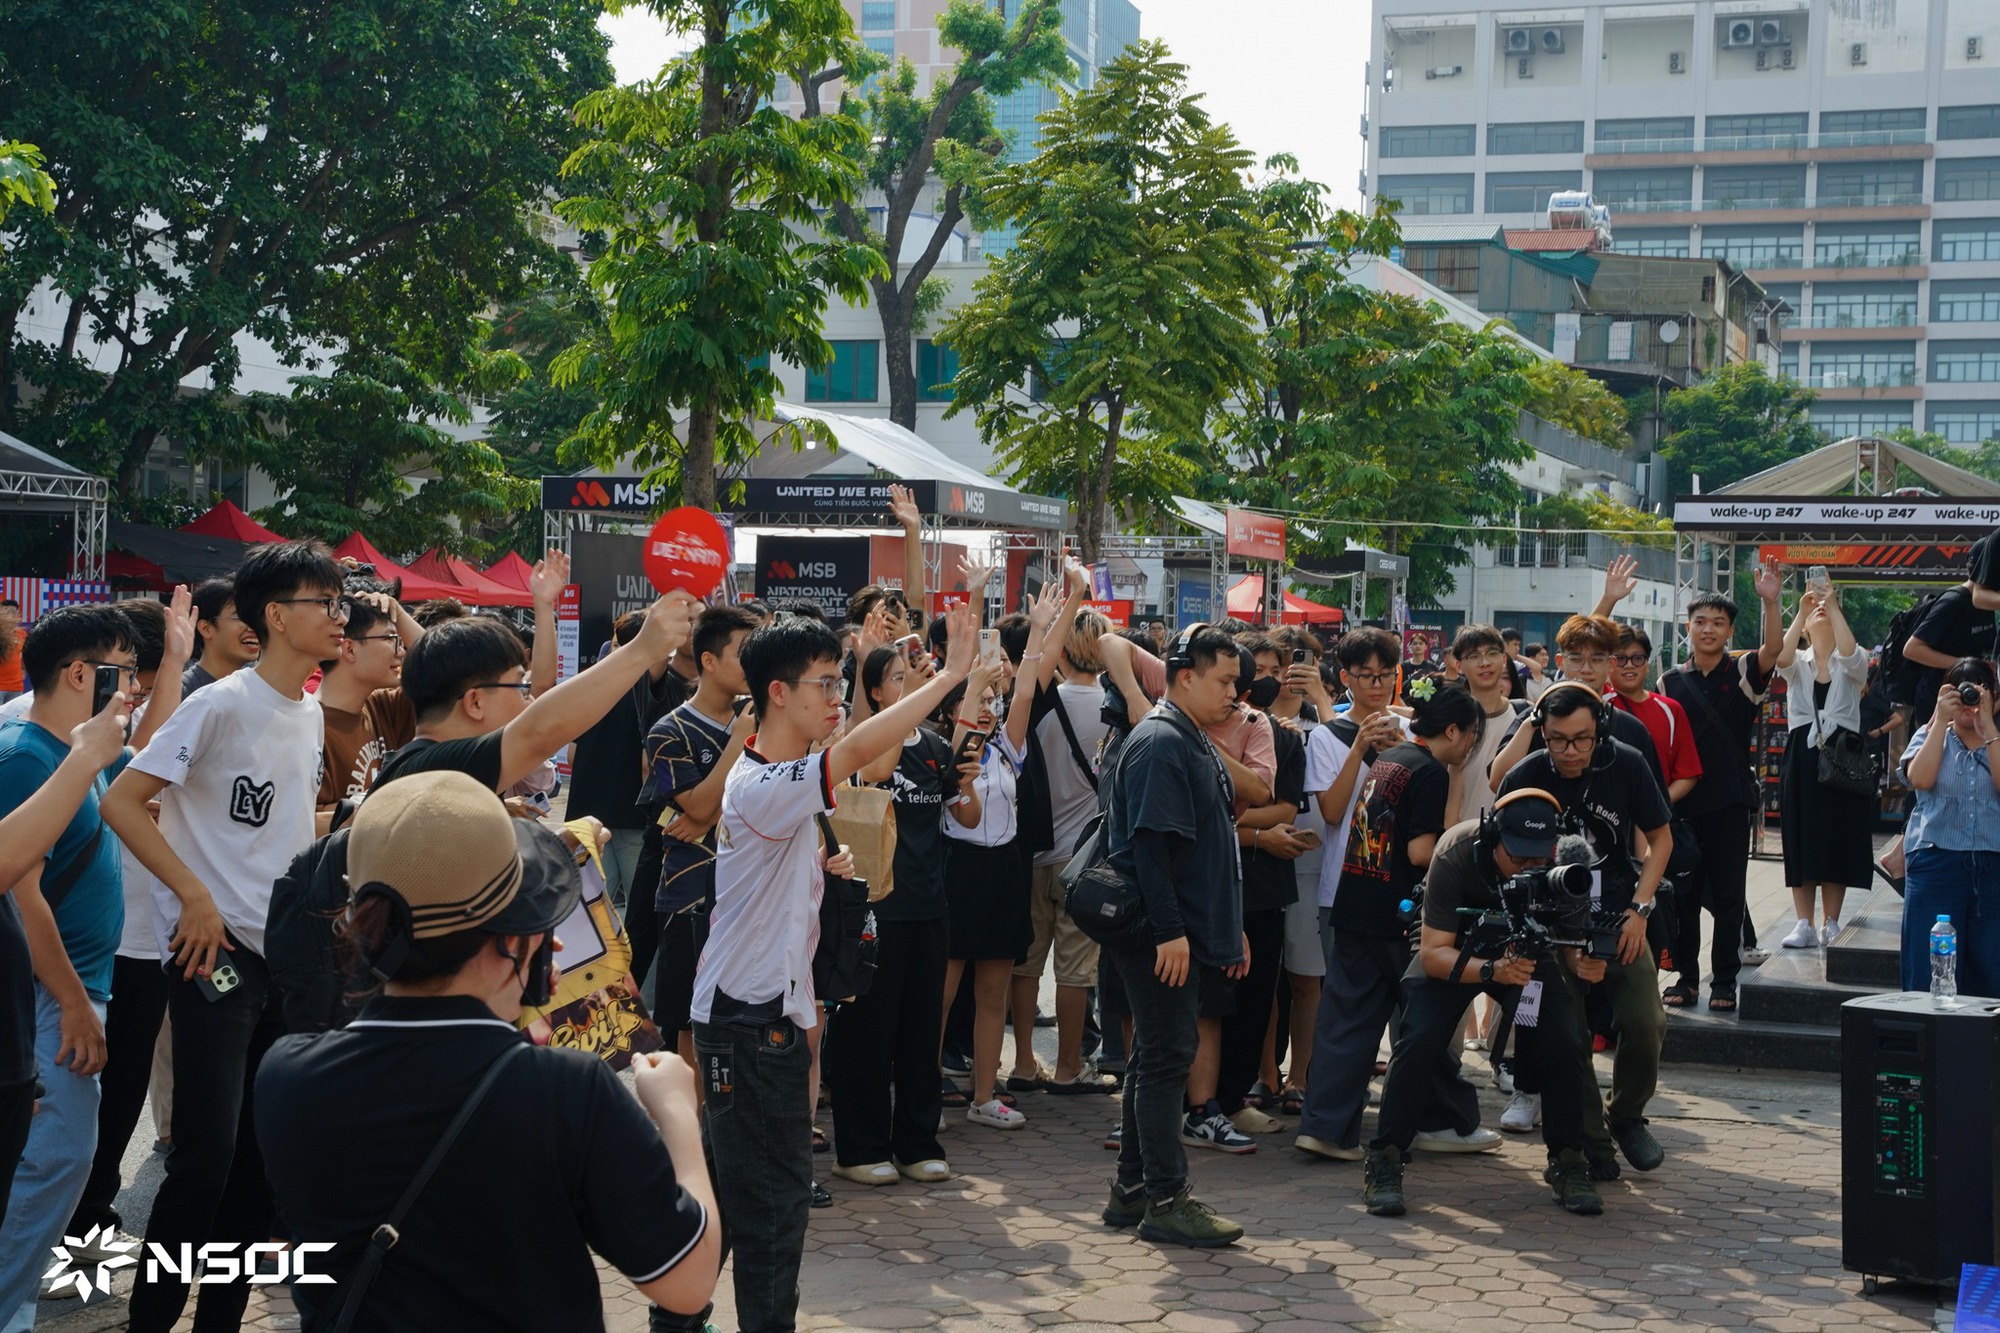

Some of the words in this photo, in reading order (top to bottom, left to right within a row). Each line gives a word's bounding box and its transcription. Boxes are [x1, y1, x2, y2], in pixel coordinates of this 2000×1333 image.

[776, 486, 835, 497] UNITED
[839, 487, 866, 497] WE
[965, 490, 985, 514] MSB
[1020, 500, 1039, 512] UNITED
[1049, 505, 1061, 516] RISE
[1710, 505, 1772, 521] wake-up
[1775, 507, 1803, 518] 247
[1821, 505, 1883, 521] wake-up
[1887, 508, 1917, 518] 247
[1935, 507, 2000, 523] wake-up
[798, 562, 837, 578] MSB
[767, 586, 848, 597] NATIONAL
[1595, 804, 1620, 826] Radio
[1524, 819, 1546, 830] Google
